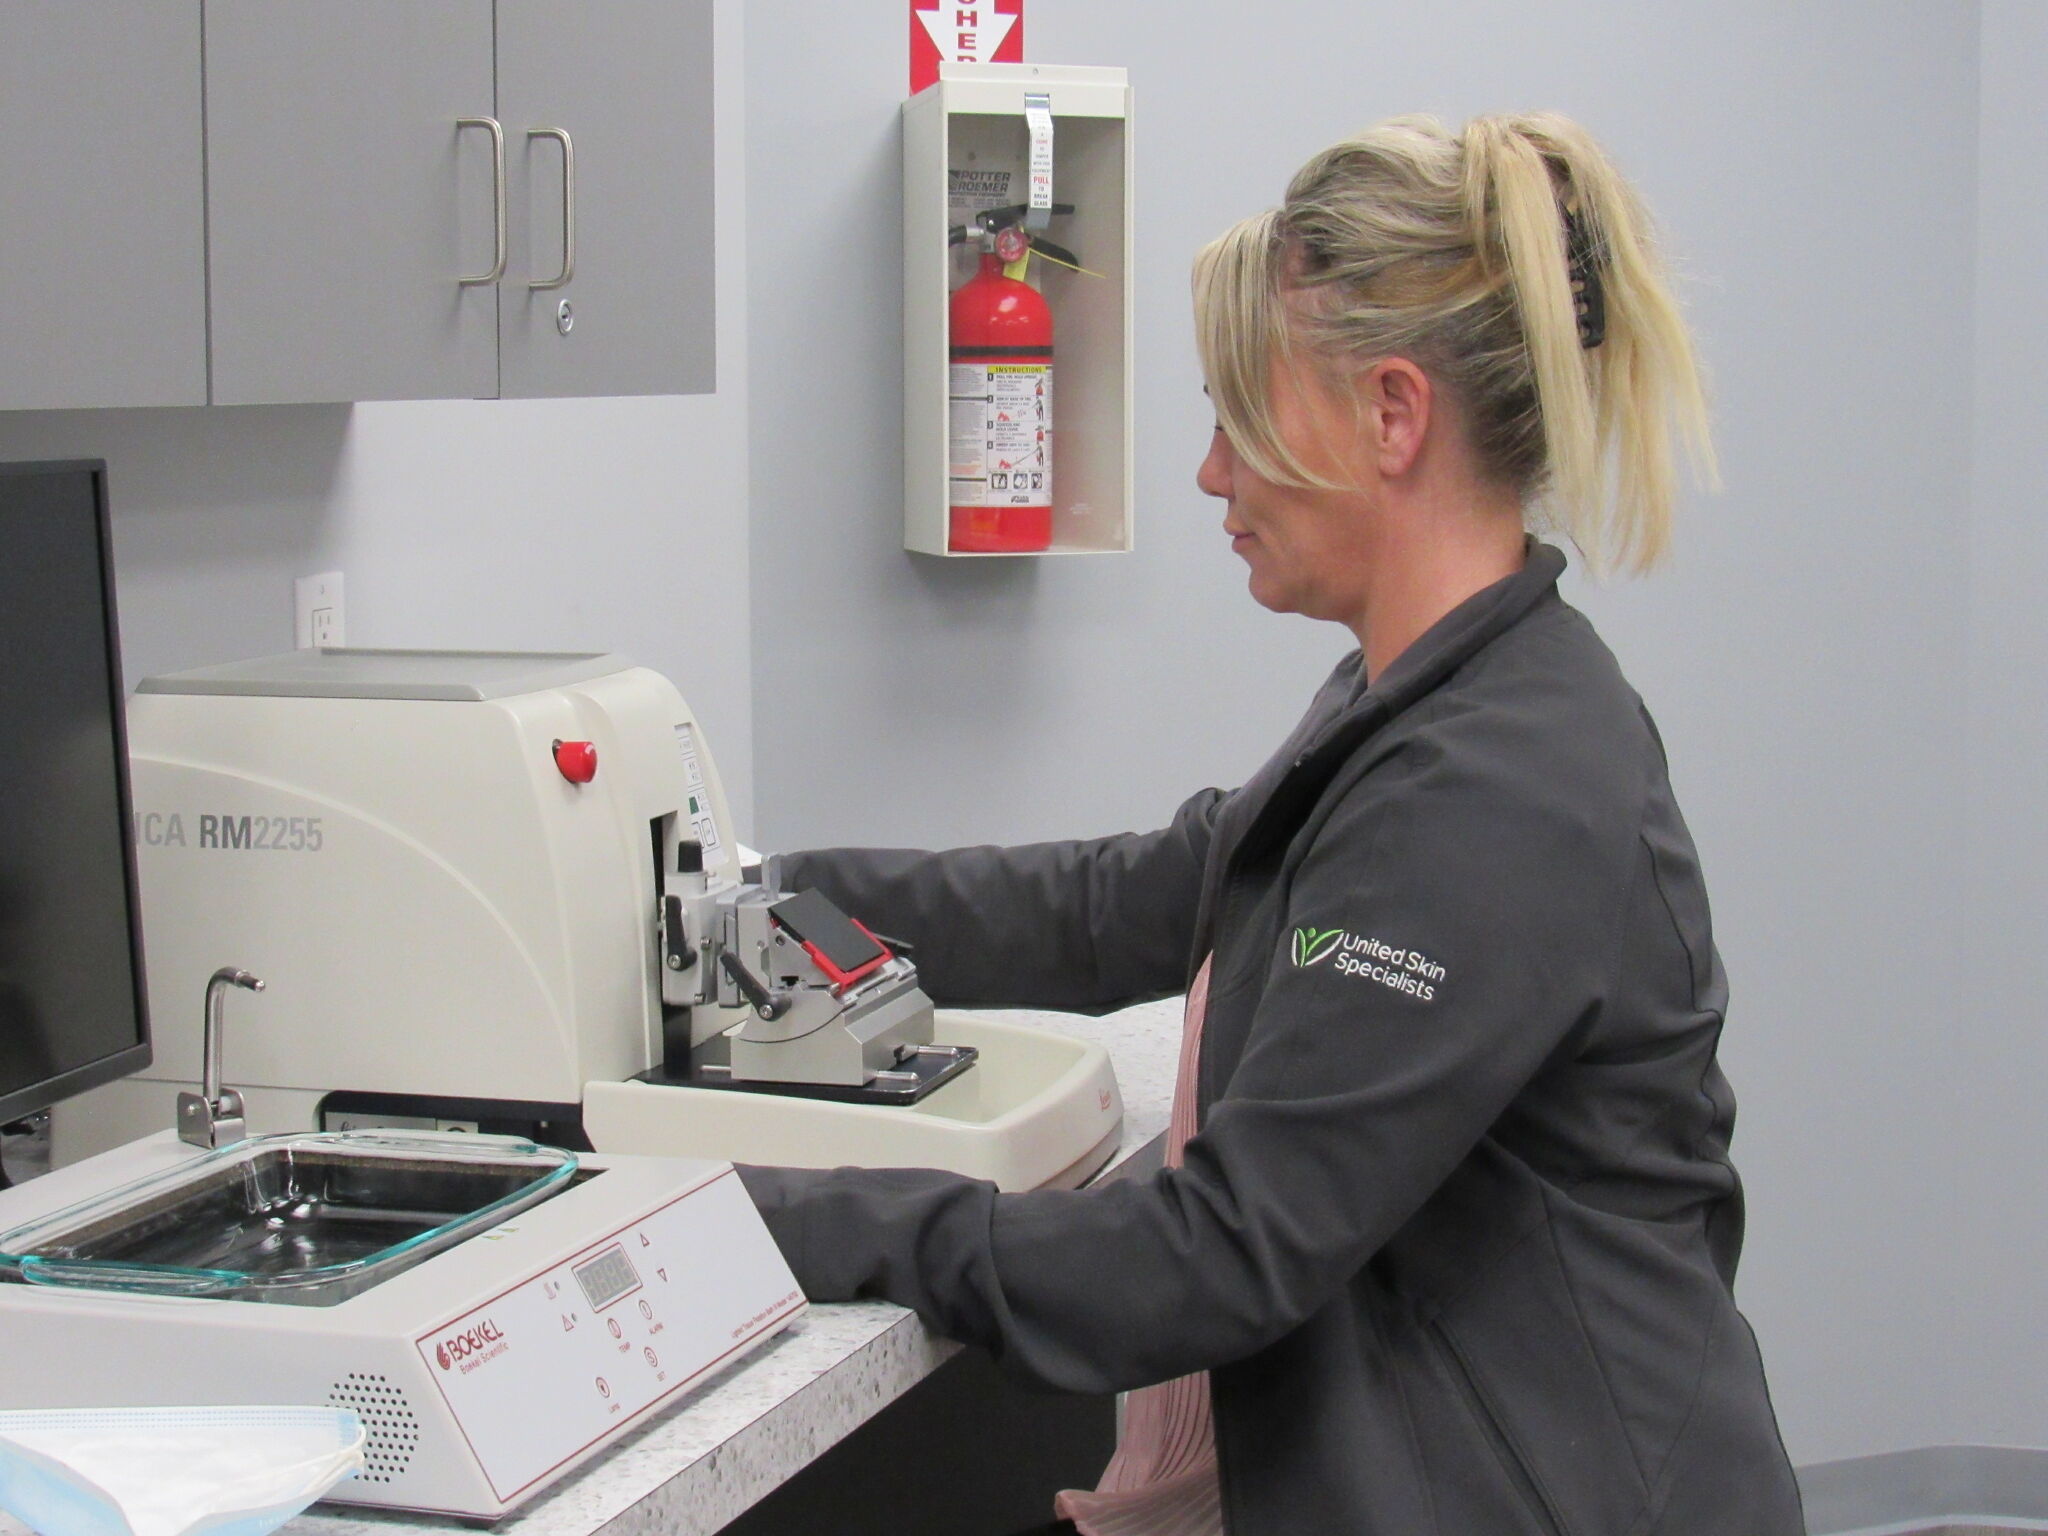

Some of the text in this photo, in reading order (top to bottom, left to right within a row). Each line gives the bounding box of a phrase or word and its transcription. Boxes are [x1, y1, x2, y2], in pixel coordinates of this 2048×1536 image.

[960, 171, 1011, 181] POTTER
[1033, 176, 1049, 184] PULL
[199, 814, 323, 852] RM2255
[1334, 952, 1436, 1001] Specialists
[1342, 933, 1447, 982] United Skin
[446, 1319, 504, 1362] BOEKEL
